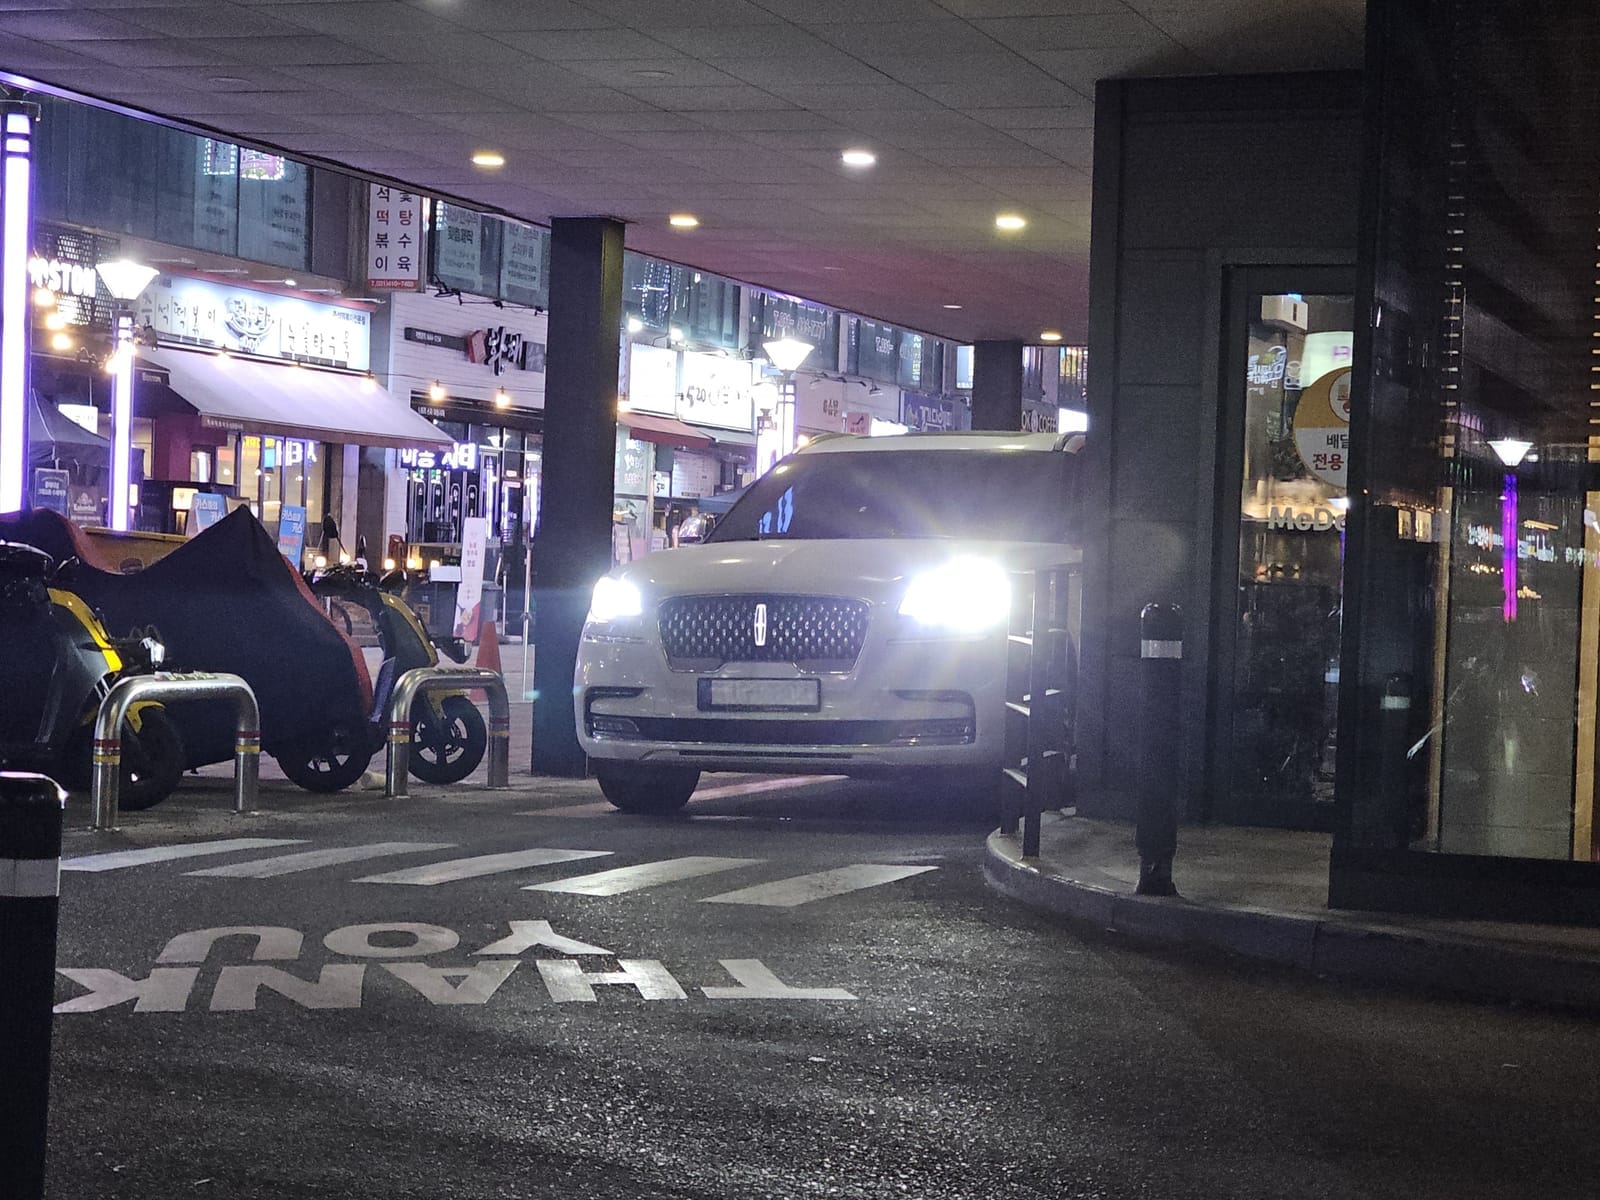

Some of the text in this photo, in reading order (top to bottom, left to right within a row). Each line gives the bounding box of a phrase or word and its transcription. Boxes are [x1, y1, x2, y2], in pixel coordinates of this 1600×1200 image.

[375, 187, 391, 272] 석떡볶이
[1312, 453, 1345, 471] 전용
[155, 919, 615, 964] YOU
[52, 957, 859, 1014] THANK
